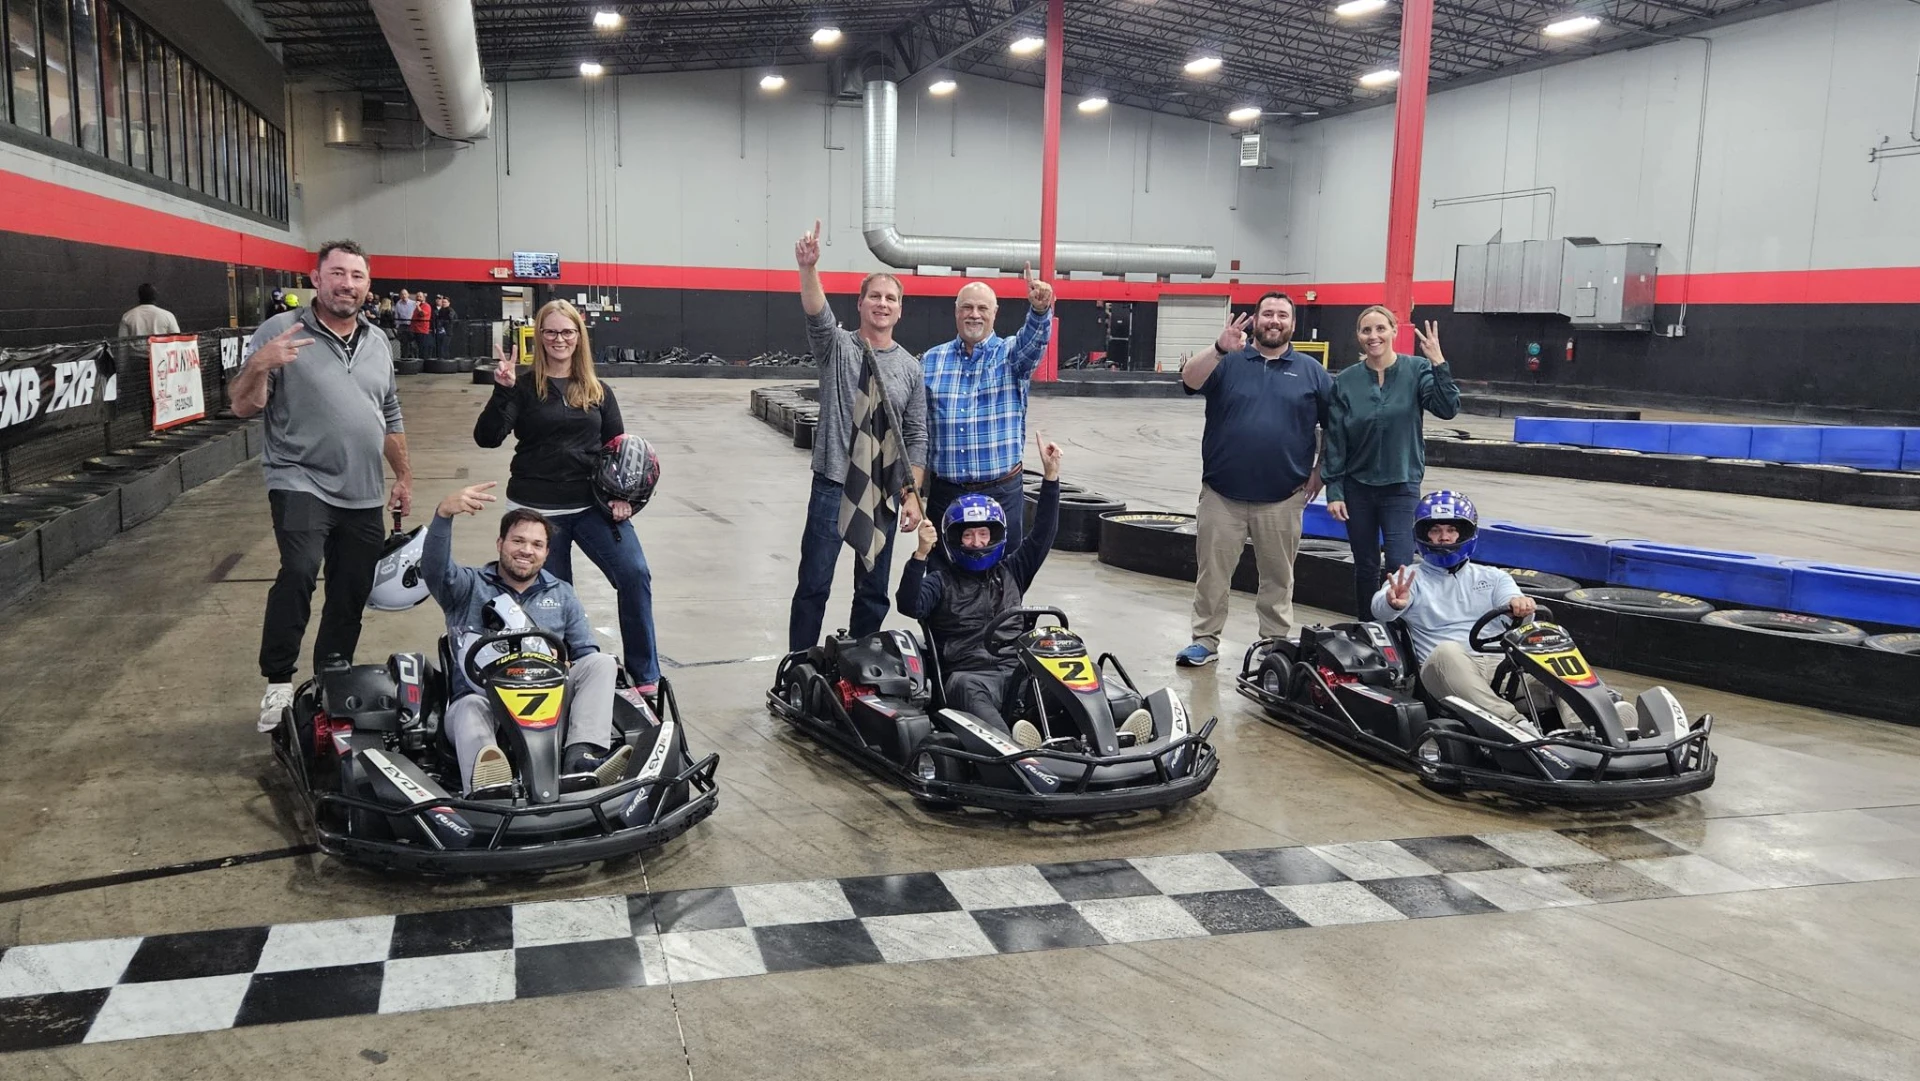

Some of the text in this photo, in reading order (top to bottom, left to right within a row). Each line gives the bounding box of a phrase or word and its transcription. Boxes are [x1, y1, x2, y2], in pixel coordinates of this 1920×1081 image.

[0, 367, 40, 429] XR
[45, 360, 97, 413] FXR
[1058, 661, 1089, 681] 2
[1544, 656, 1586, 676] 10
[517, 693, 549, 716] 7
